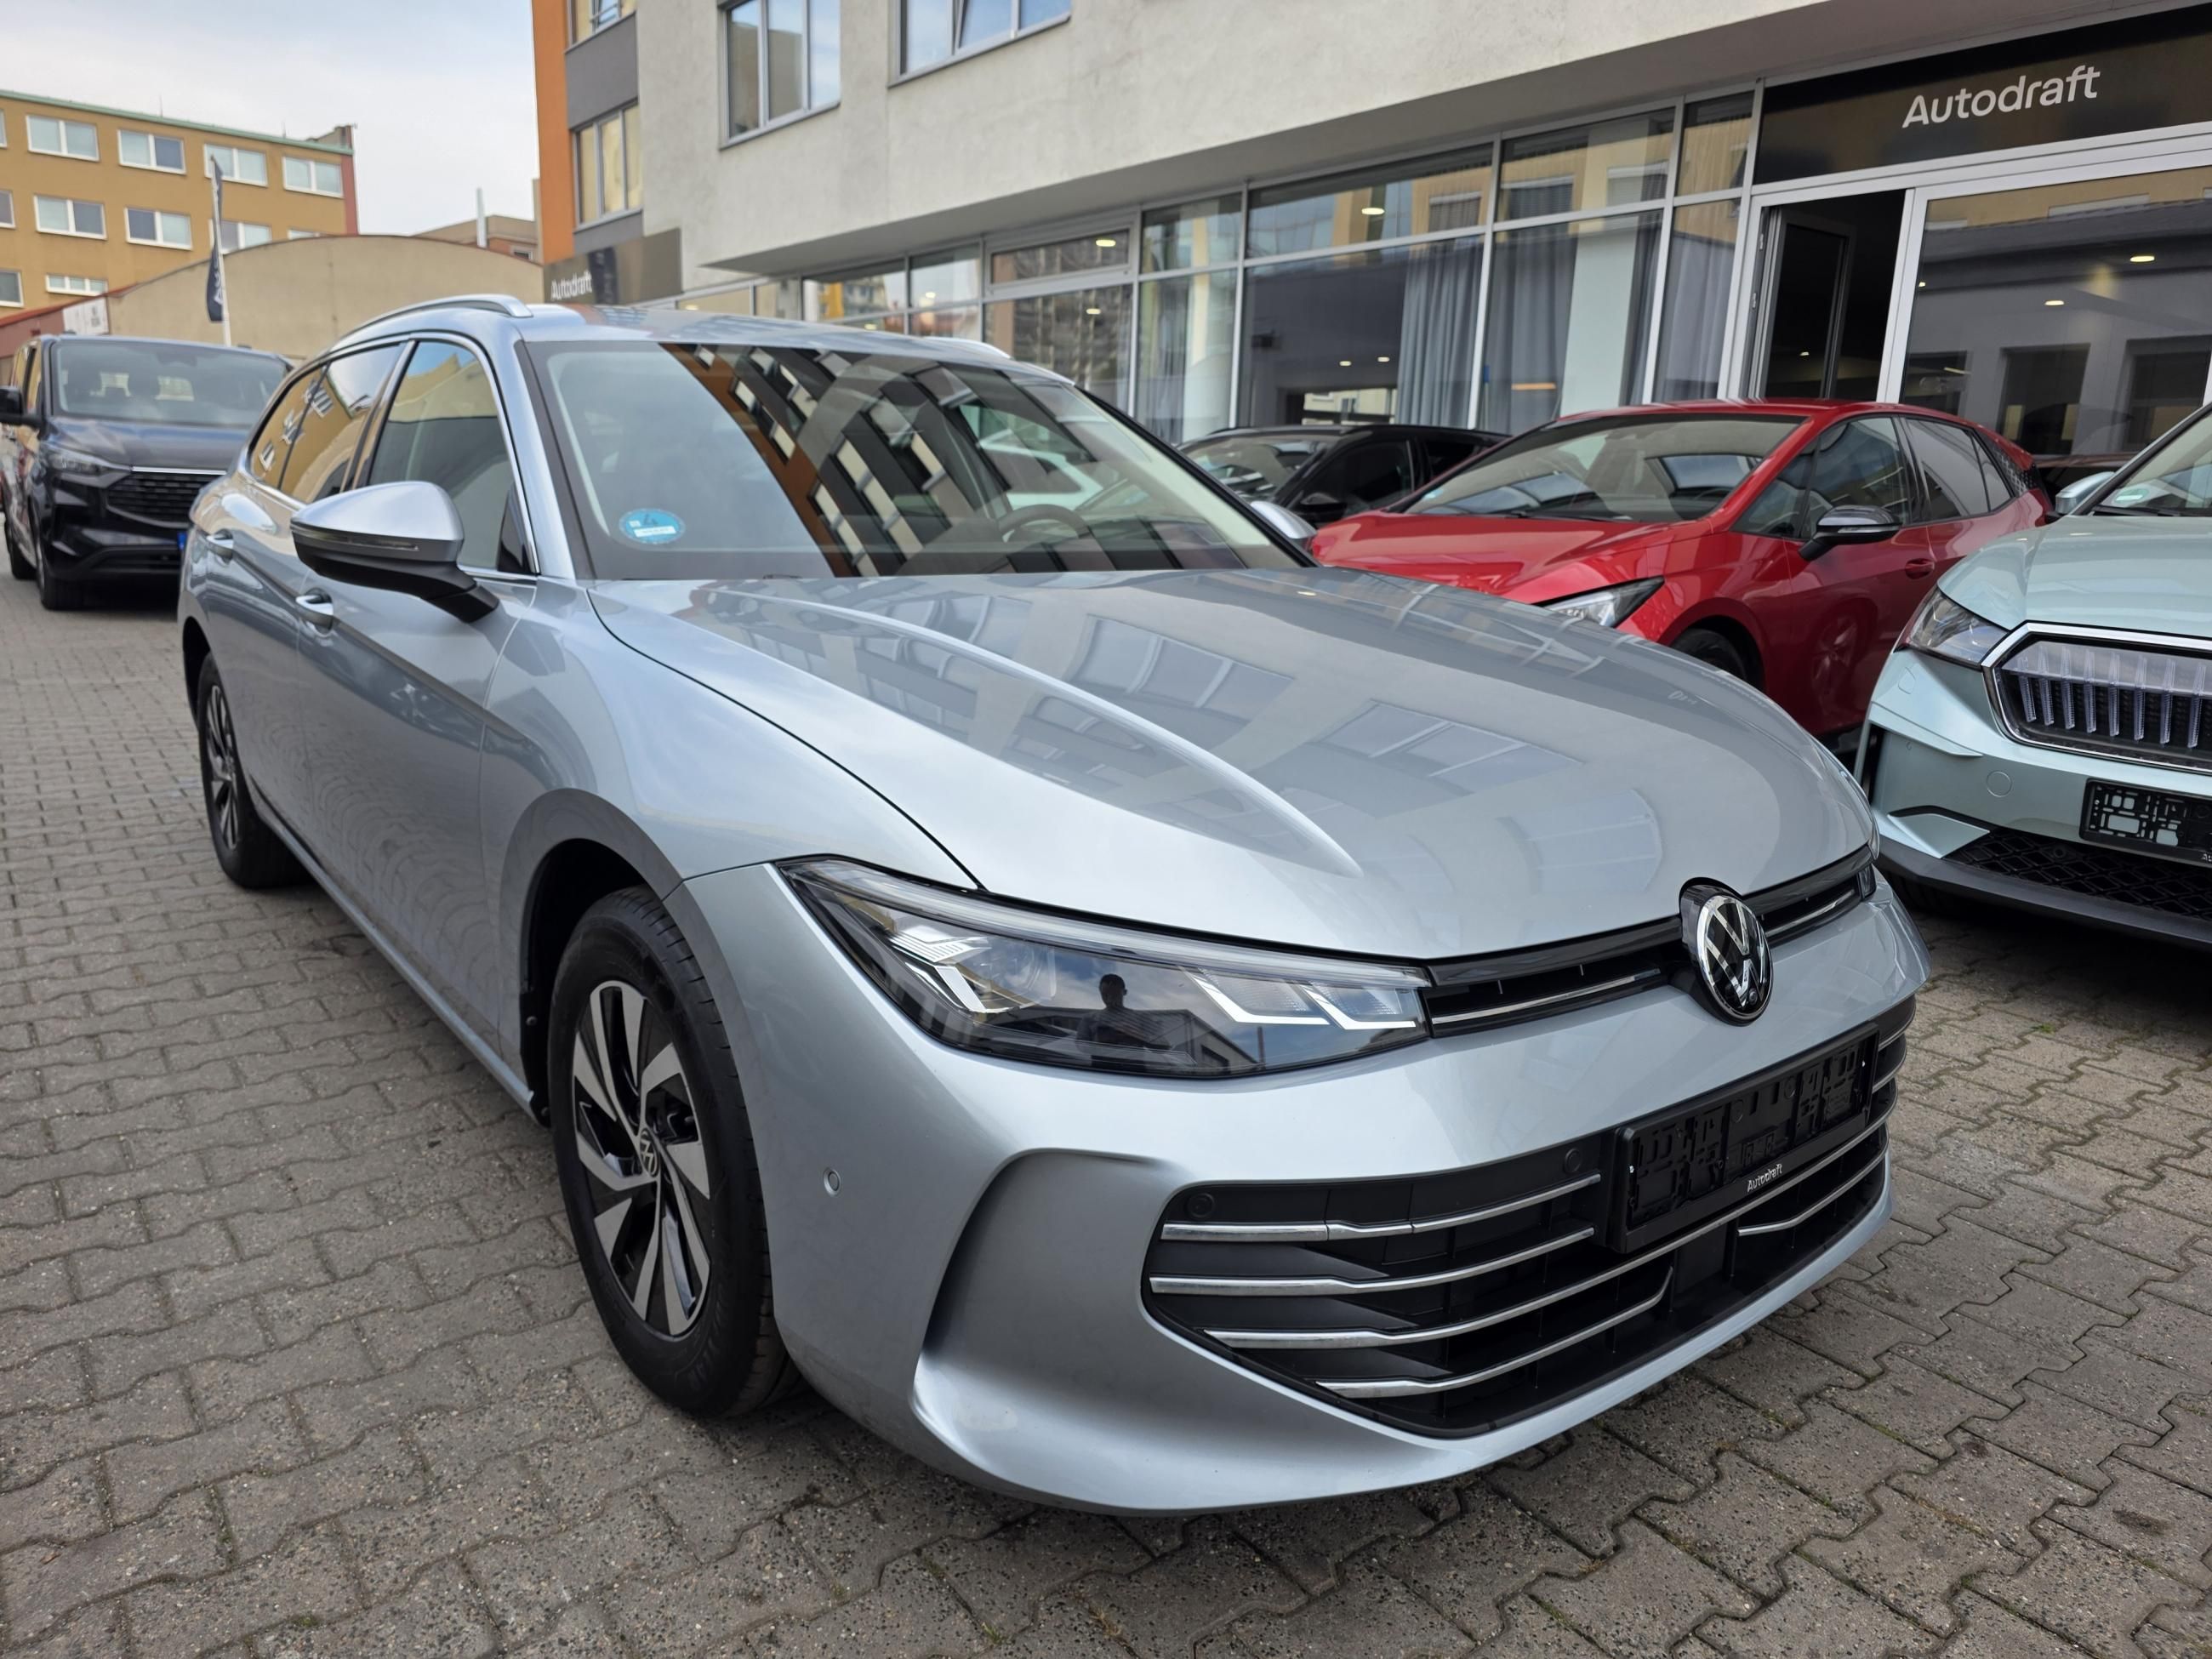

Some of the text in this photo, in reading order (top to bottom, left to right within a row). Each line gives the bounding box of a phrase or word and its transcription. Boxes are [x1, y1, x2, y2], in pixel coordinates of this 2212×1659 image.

[1901, 65, 2101, 128] Autodraft
[550, 270, 593, 300] Autodraft
[1747, 1163, 1783, 1193] Autodraft
